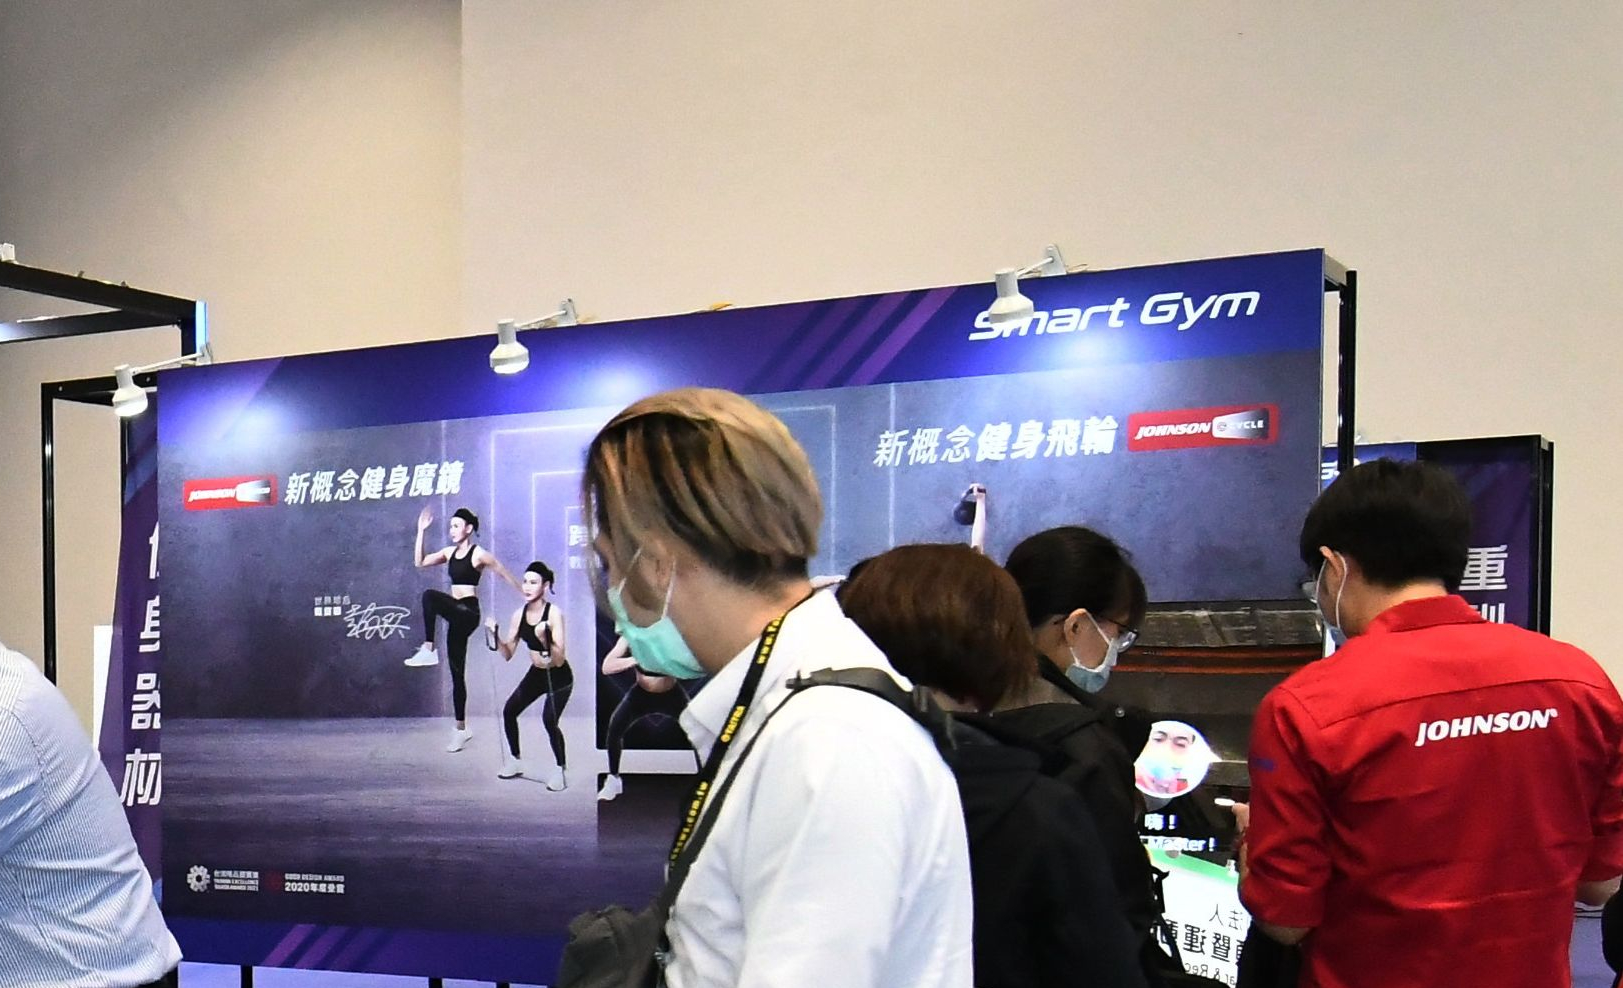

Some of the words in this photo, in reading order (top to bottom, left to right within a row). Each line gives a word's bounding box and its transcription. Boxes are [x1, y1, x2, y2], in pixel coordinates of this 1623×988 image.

[1140, 292, 1260, 331] Gym
[873, 415, 1119, 468] 新概念健身飛輪
[1134, 422, 1211, 440] JOHNSON
[283, 460, 465, 505] 新概念健身魔鏡
[1415, 709, 1551, 748] JOHNSON
